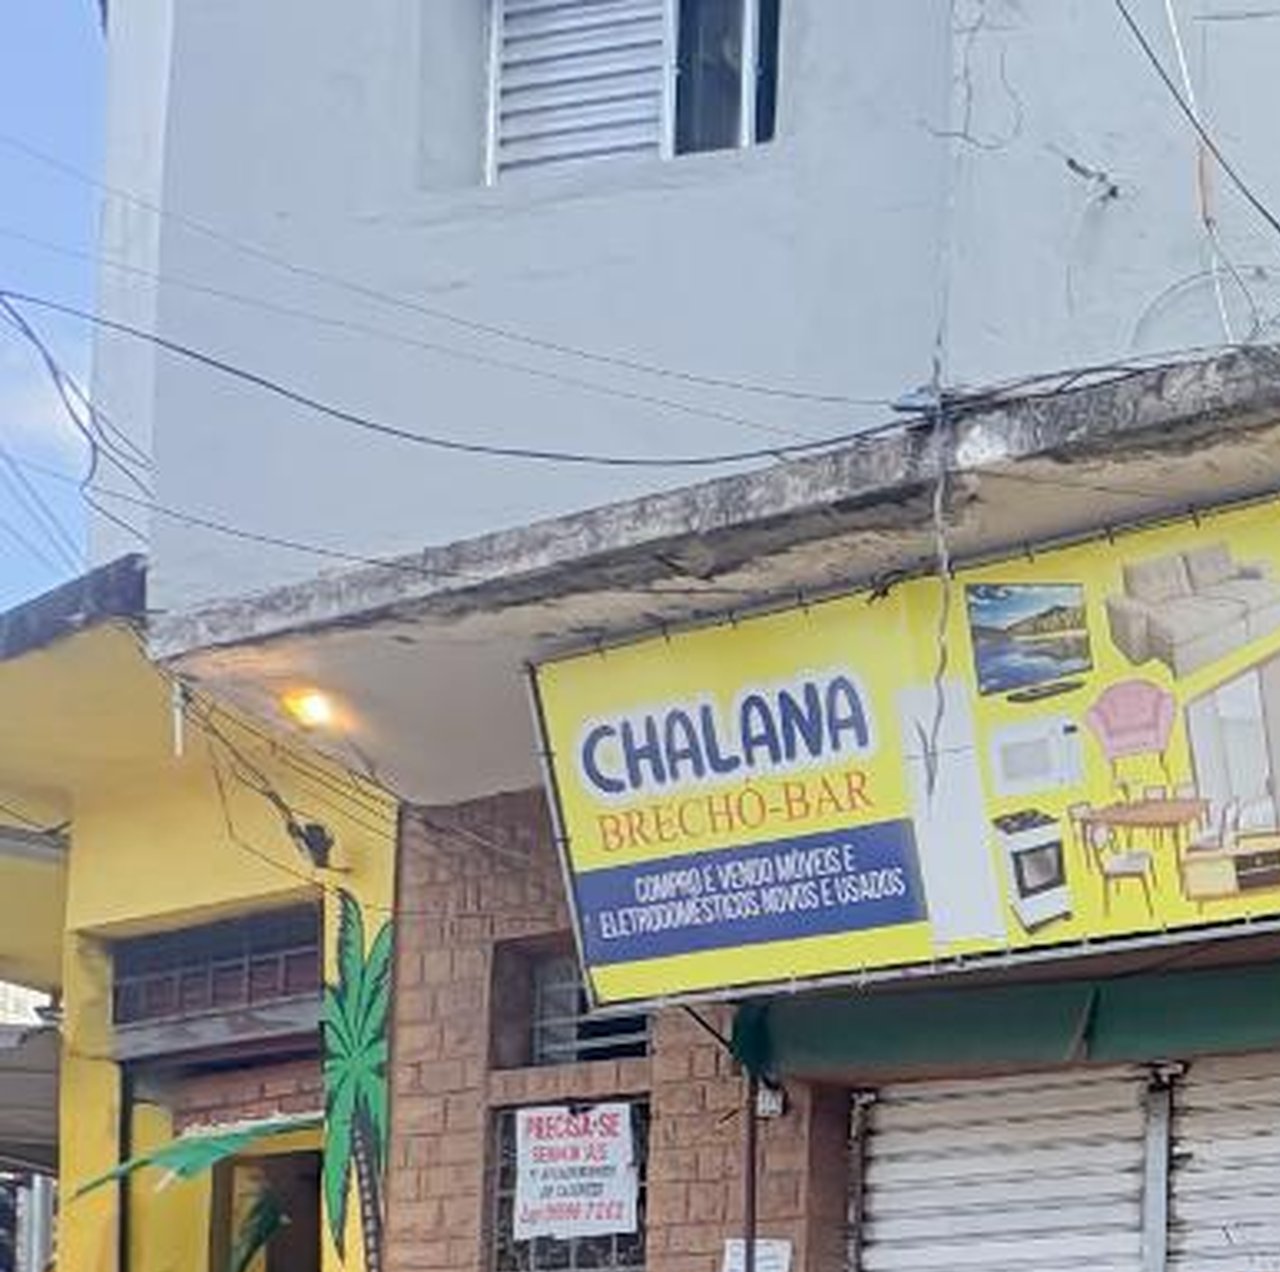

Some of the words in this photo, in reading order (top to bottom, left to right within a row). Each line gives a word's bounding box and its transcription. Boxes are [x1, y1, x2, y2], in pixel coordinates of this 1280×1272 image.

[581, 674, 870, 793] CHALANA
[634, 867, 702, 903] COMPRO
[703, 865, 716, 893] E
[718, 857, 774, 890] VENDO
[842, 844, 854, 872] E
[821, 877, 832, 906] E
[833, 867, 906, 902] USADOS
